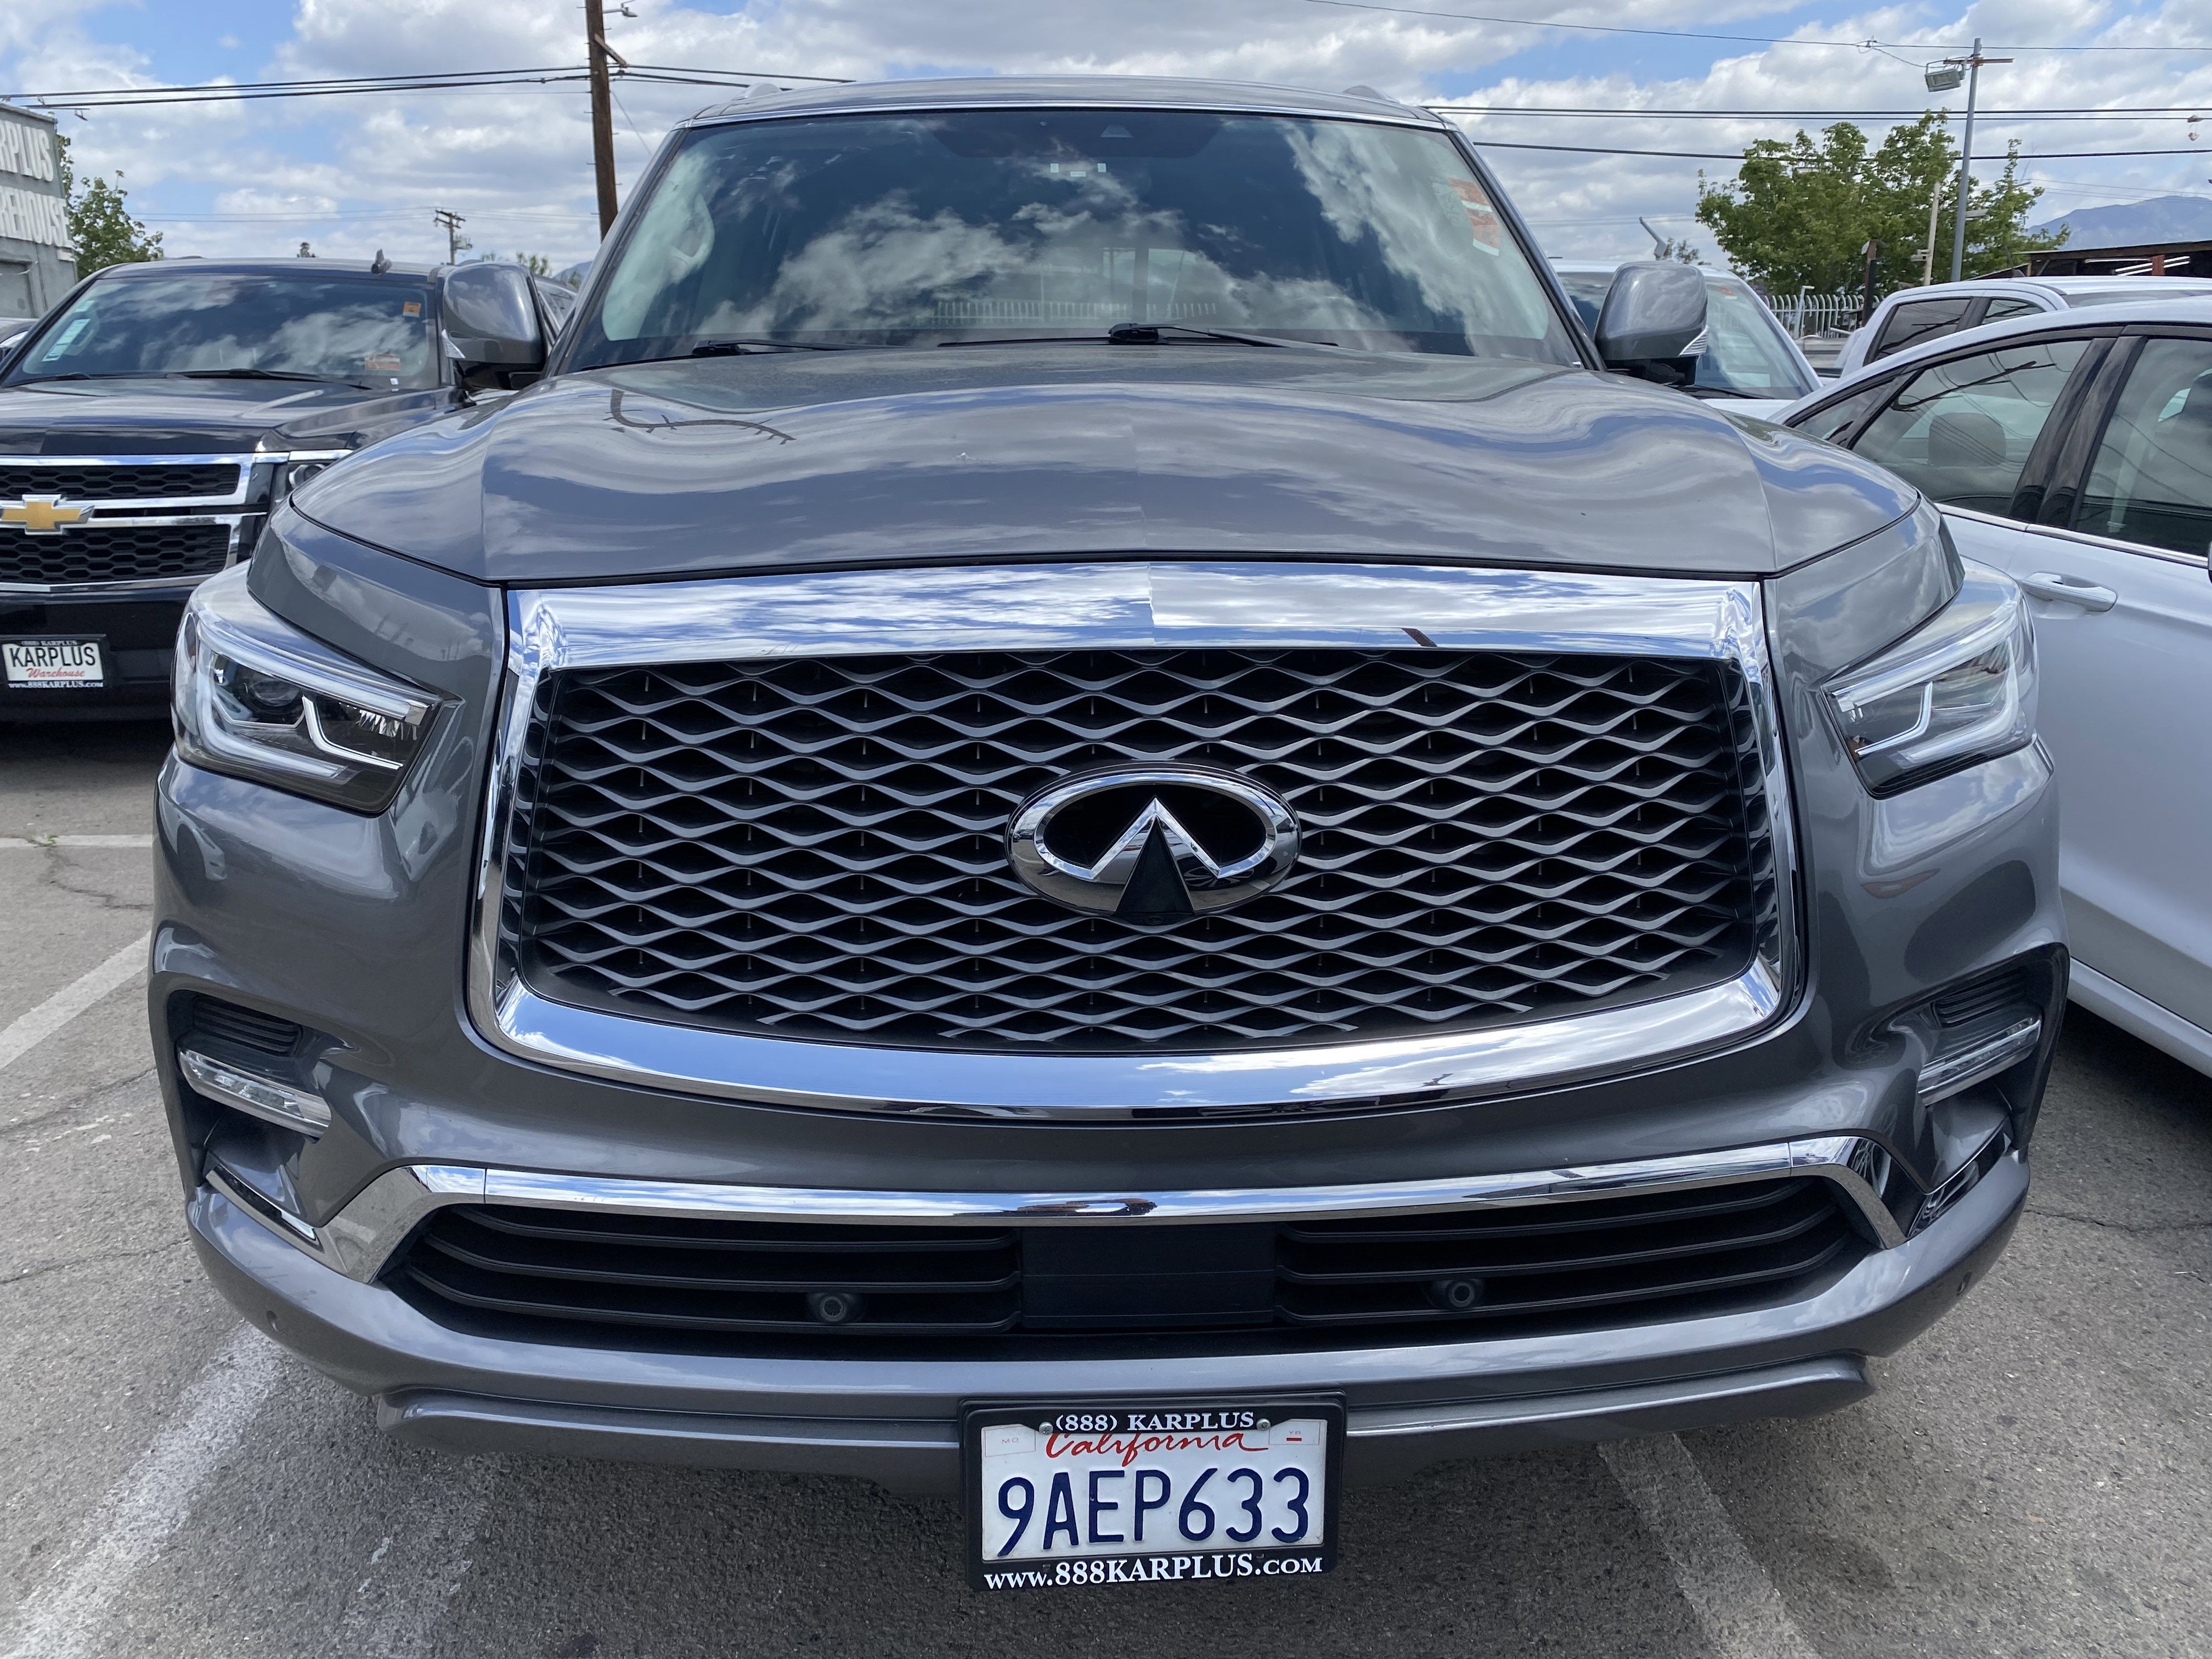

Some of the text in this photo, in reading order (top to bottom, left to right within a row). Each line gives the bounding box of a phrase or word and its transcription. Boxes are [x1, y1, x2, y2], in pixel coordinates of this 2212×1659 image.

[9, 646, 95, 667] KARPLUS
[26, 667, 85, 678] Warehouse
[1056, 1412, 1254, 1433] (888) KARPLUS
[1046, 1432, 1269, 1467] California
[997, 1468, 1310, 1557] 9AEP633
